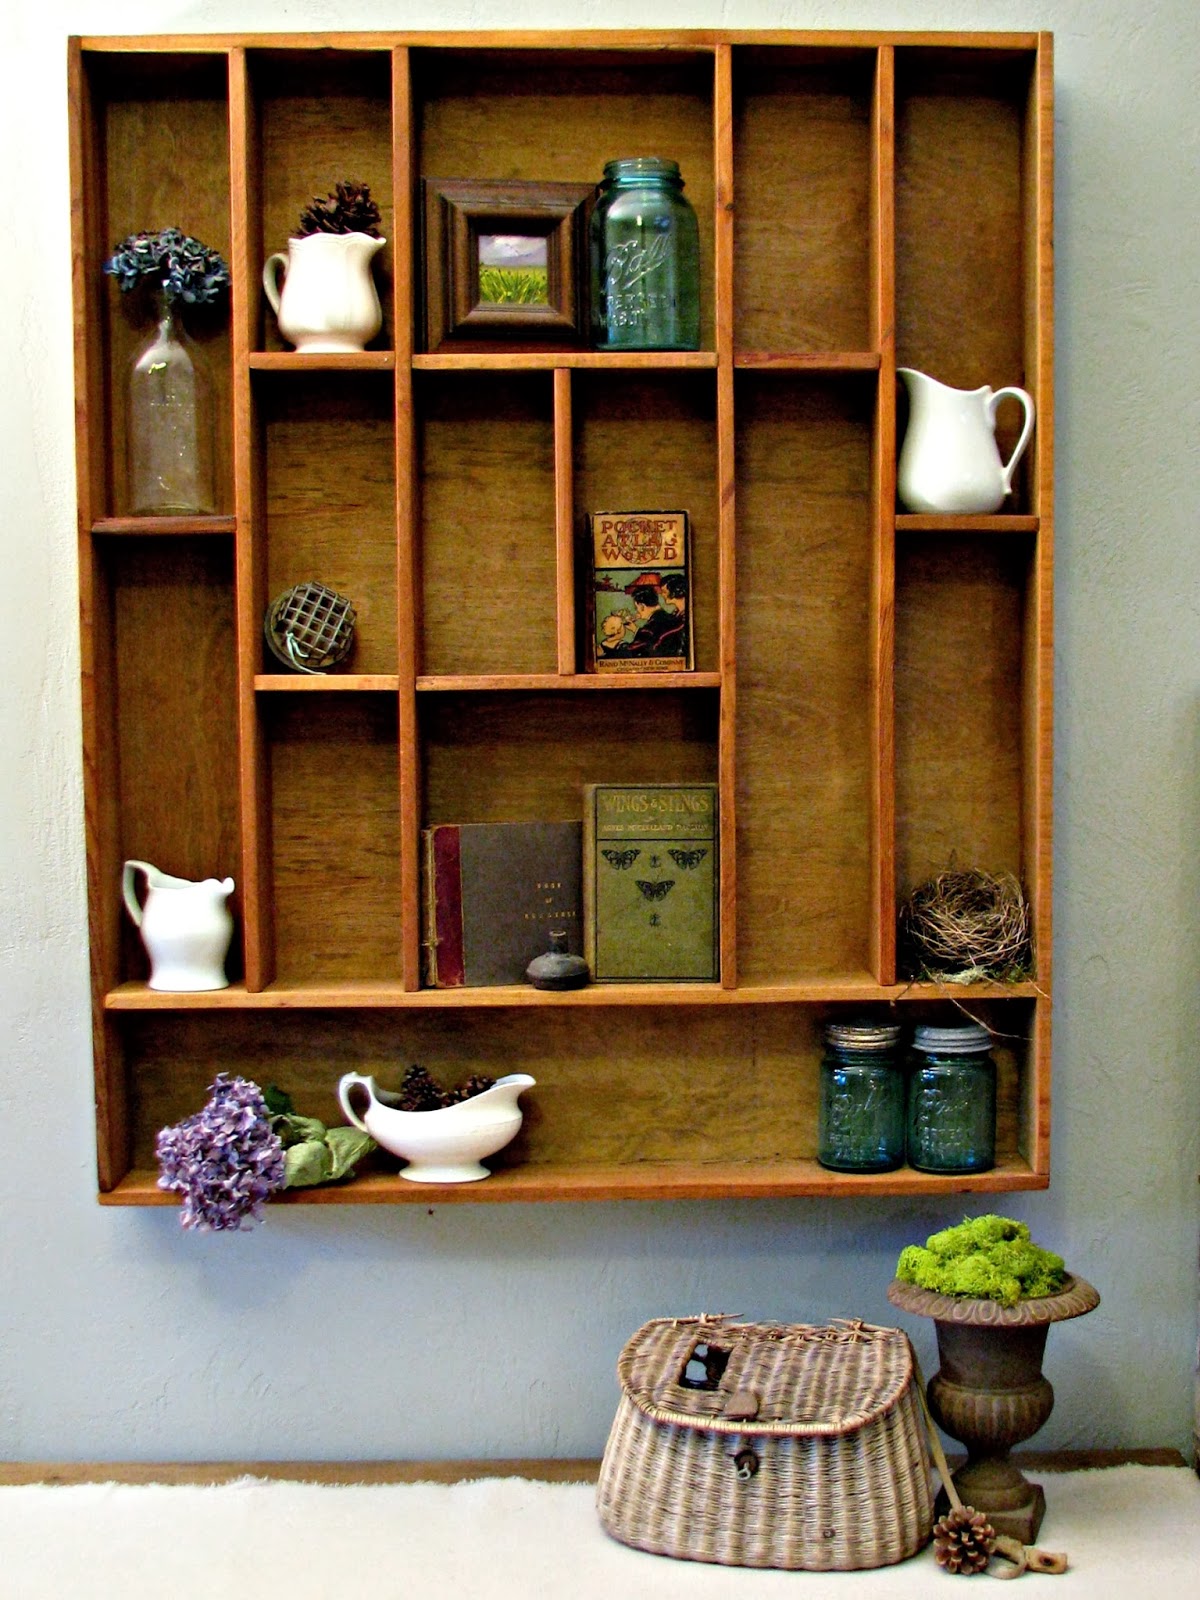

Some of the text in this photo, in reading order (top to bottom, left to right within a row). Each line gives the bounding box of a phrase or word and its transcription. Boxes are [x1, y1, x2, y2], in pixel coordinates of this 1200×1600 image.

[601, 519, 678, 534] POCKET
[601, 533, 678, 548] ATLAS
[601, 547, 678, 562] WORLD
[599, 660, 618, 668] RAND
[601, 794, 709, 813] WINGS & STINGS
